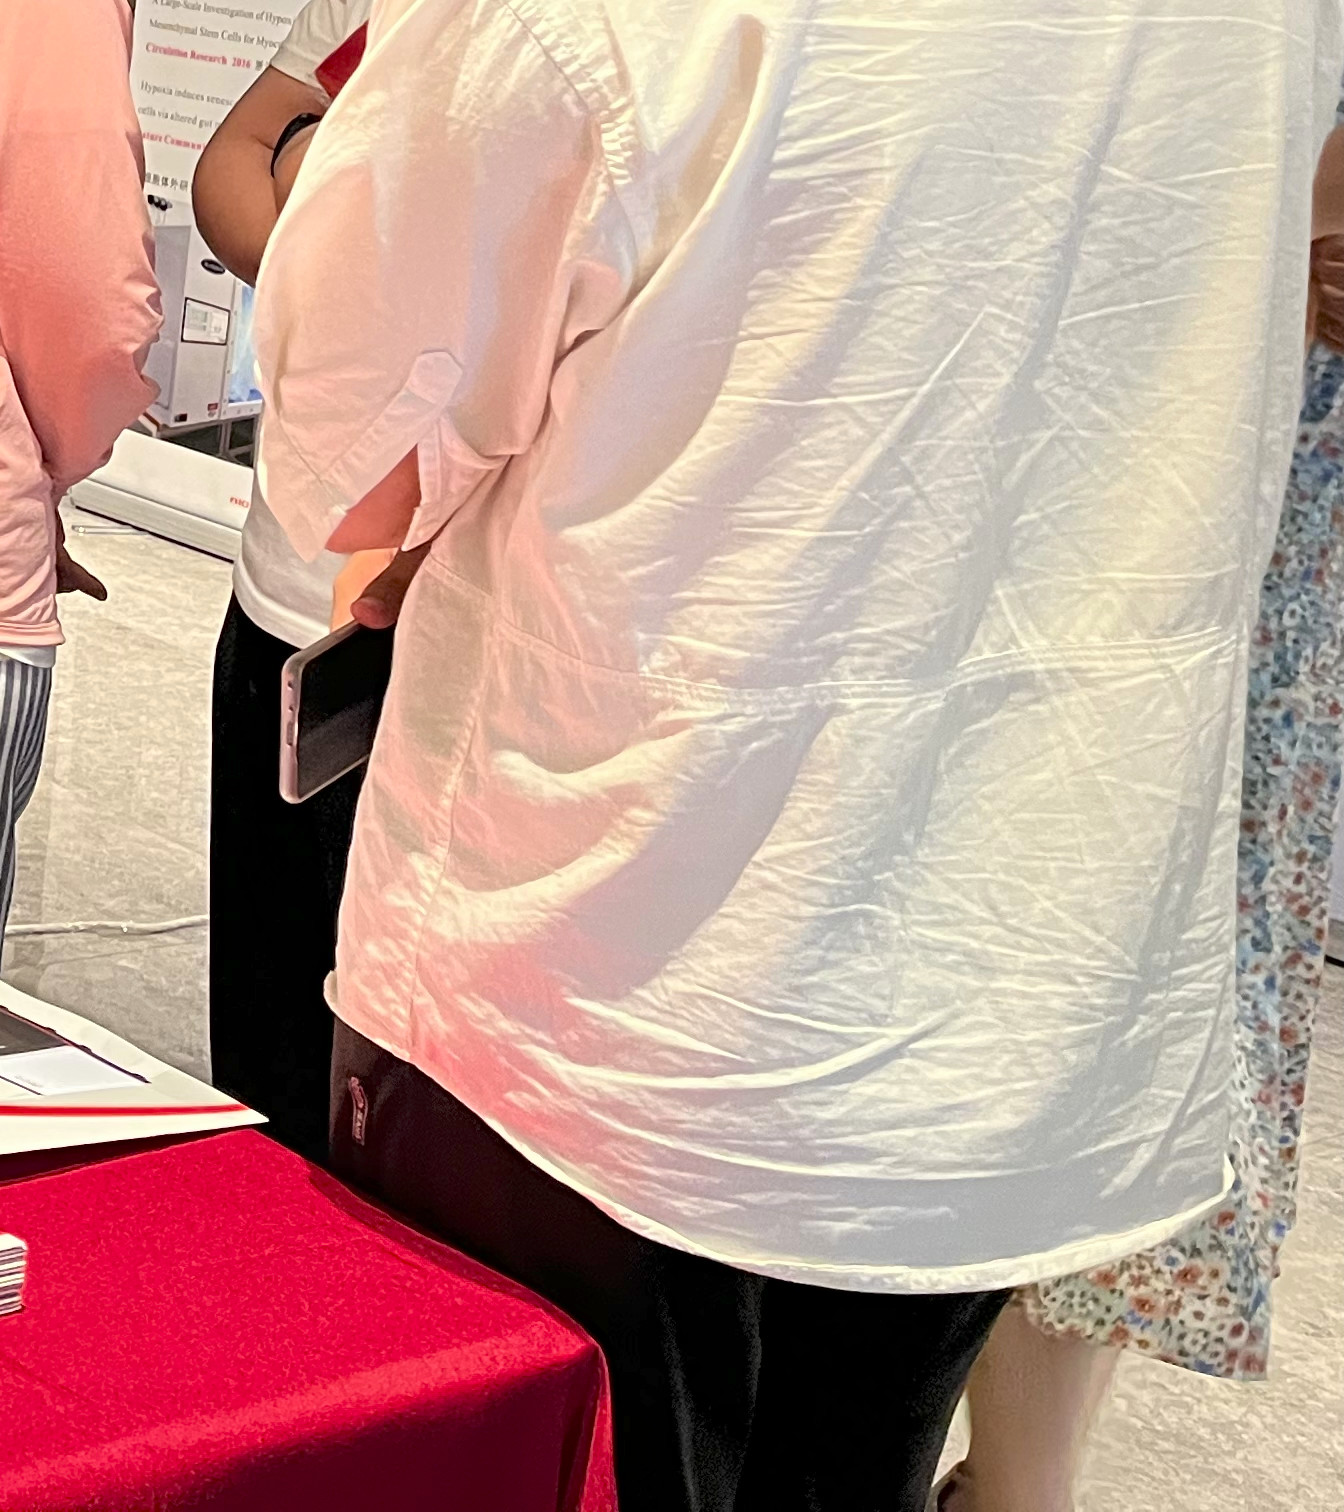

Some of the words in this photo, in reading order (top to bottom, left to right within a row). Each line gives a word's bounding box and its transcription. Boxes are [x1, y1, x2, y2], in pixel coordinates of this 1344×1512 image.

[221, 30, 241, 42] Cells
[190, 50, 227, 65] Research
[140, 80, 172, 95] Hypoxia
[174, 89, 204, 101] induces
[170, 112, 197, 125] altered
